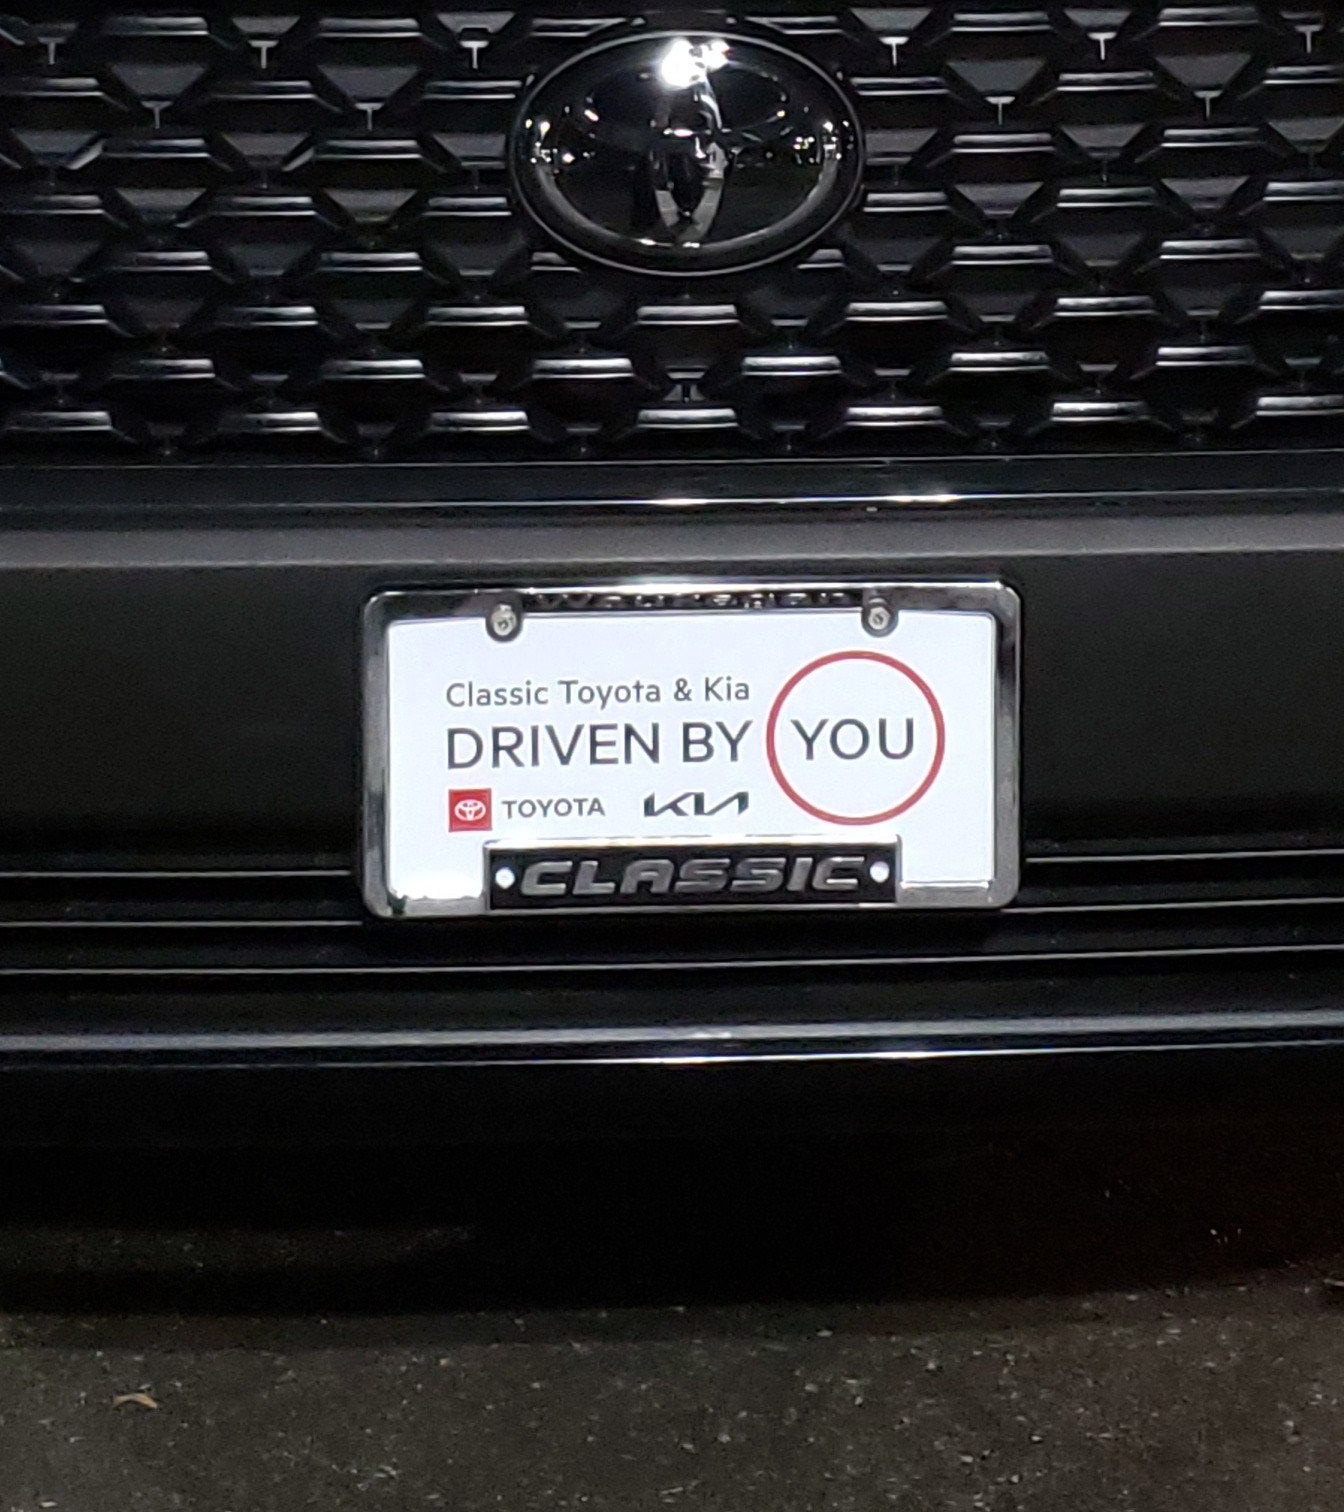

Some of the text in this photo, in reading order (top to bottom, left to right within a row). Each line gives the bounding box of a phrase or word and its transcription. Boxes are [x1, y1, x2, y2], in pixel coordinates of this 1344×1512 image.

[446, 676, 750, 709] Classic Toyota & Kia
[447, 718, 914, 769] DRIVEN BY YOU
[502, 798, 605, 818] TOYOTA
[520, 856, 865, 895] CLASSIC
